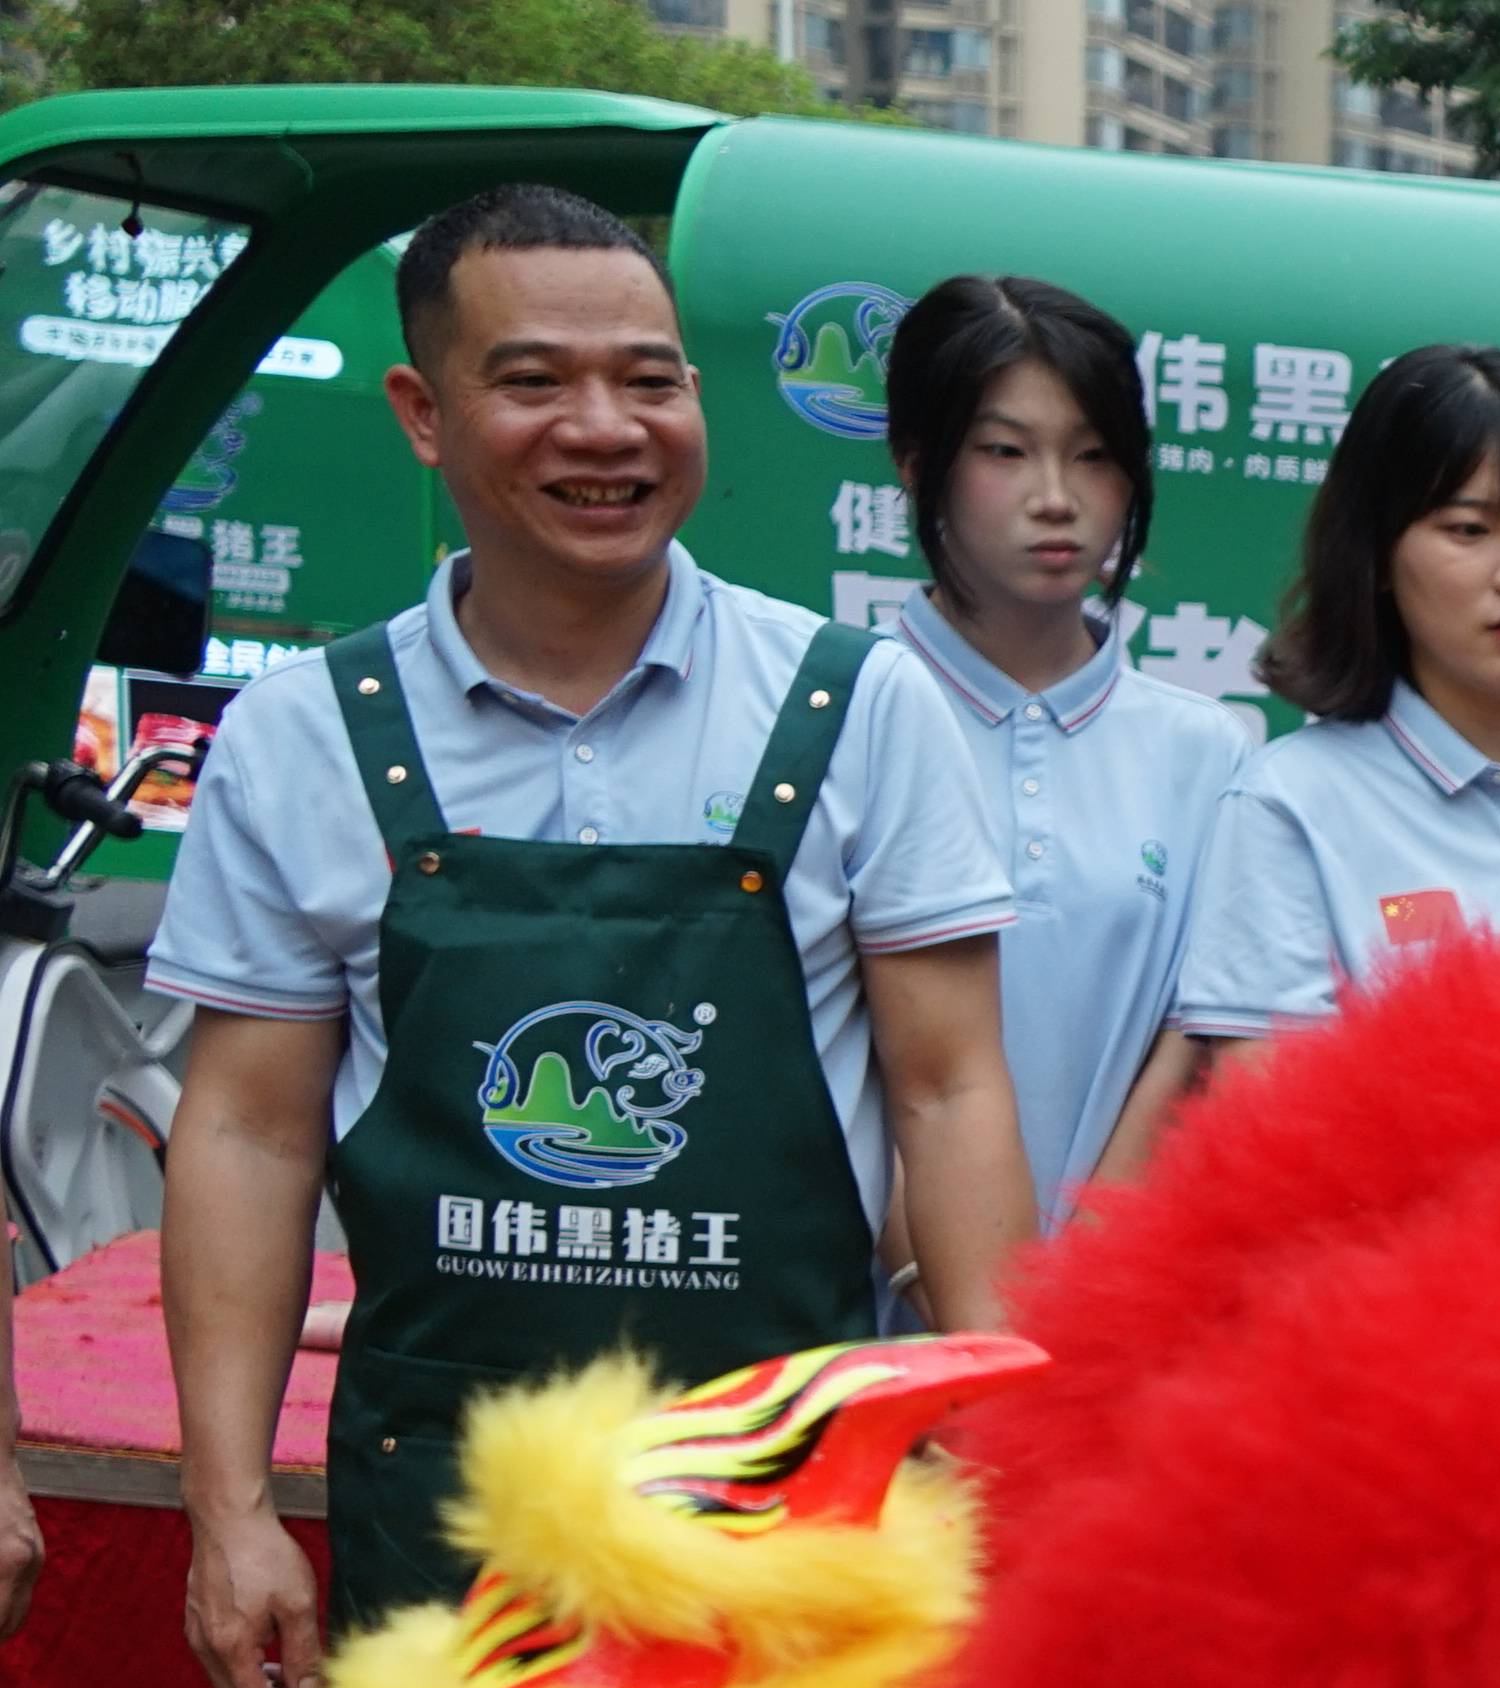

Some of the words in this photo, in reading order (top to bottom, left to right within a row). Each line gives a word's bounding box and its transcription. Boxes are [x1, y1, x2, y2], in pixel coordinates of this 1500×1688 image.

[65, 270, 214, 325] 移动服
[437, 1194, 742, 1266] 国伟黑猪王
[436, 1253, 741, 1291] GUOWEIHEIZHUWANG
